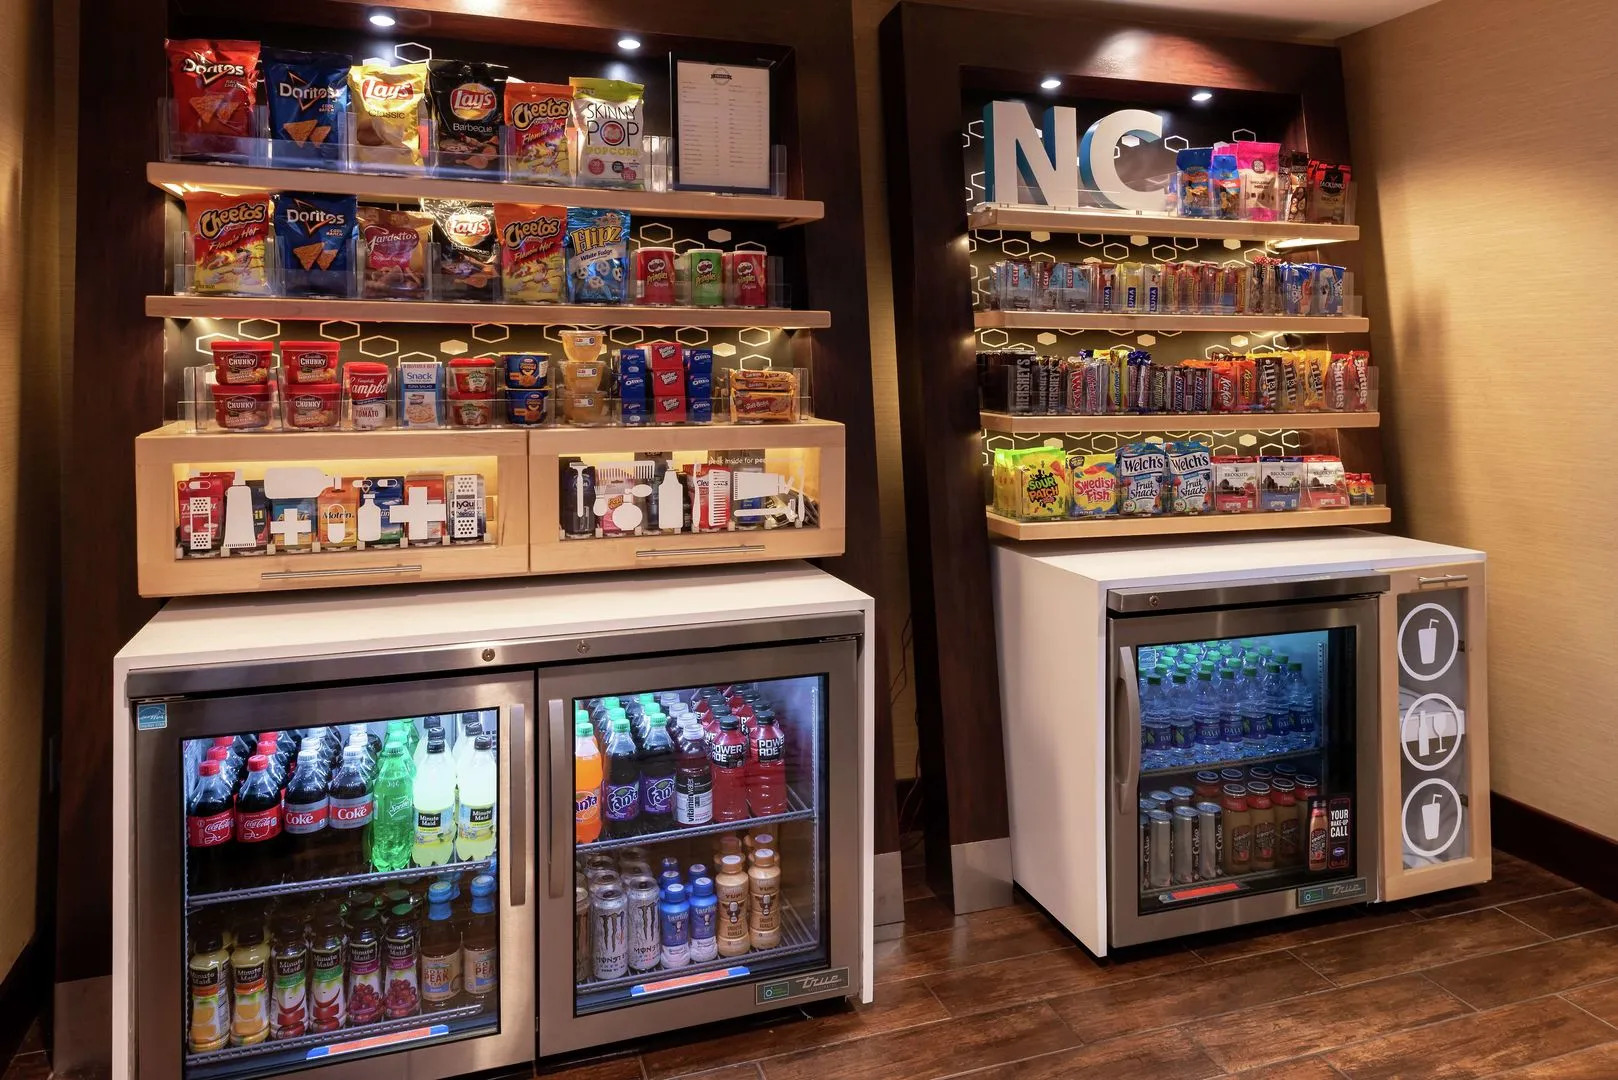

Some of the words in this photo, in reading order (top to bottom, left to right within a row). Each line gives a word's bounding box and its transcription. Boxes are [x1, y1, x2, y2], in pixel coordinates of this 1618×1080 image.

[183, 58, 244, 76] Doritos
[280, 82, 340, 99] Doritos
[369, 109, 406, 119] Classic
[512, 98, 569, 130] Cheetos
[587, 102, 637, 120] SKINNY
[452, 122, 493, 133] Barbecue
[587, 120, 639, 147] POP
[585, 146, 638, 156] POPCORN
[199, 203, 266, 239] Cheetos
[286, 209, 345, 225] Doritos
[504, 217, 561, 249] Cheetos
[571, 226, 622, 255] Flipz
[228, 357, 256, 367] CHUNKY
[300, 357, 326, 367] CHUNKY
[406, 372, 433, 380] Snack
[1354, 359, 1368, 405] Skittles
[1016, 358, 1030, 410] HERSHEY'S
[1331, 362, 1345, 409] Skittles
[227, 400, 254, 410] CHUNKY
[295, 400, 321, 409] CHUNKY
[744, 455, 754, 464] for
[1123, 455, 1164, 473] Welch's
[1171, 453, 1209, 472] Welch's
[1029, 476, 1056, 490] SOUR
[1074, 478, 1116, 495] Swedish
[1135, 480, 1154, 491] Fruit
[1185, 479, 1203, 490] Fruit
[1028, 486, 1059, 500] PATCH
[1086, 489, 1111, 504] Fish
[1130, 487, 1158, 500] Snacks
[1180, 485, 1208, 497] Snacks
[758, 735, 785, 749] POWE
[712, 744, 743, 755] POWER
[759, 748, 779, 757] ADE
[712, 753, 727, 762] ADE
[286, 813, 314, 826] Coke
[337, 806, 368, 821] Coke
[1330, 809, 1349, 820] YOUR
[1330, 827, 1348, 838] CALL
[475, 967, 496, 975] PEA
[424, 973, 450, 983] PEAK
